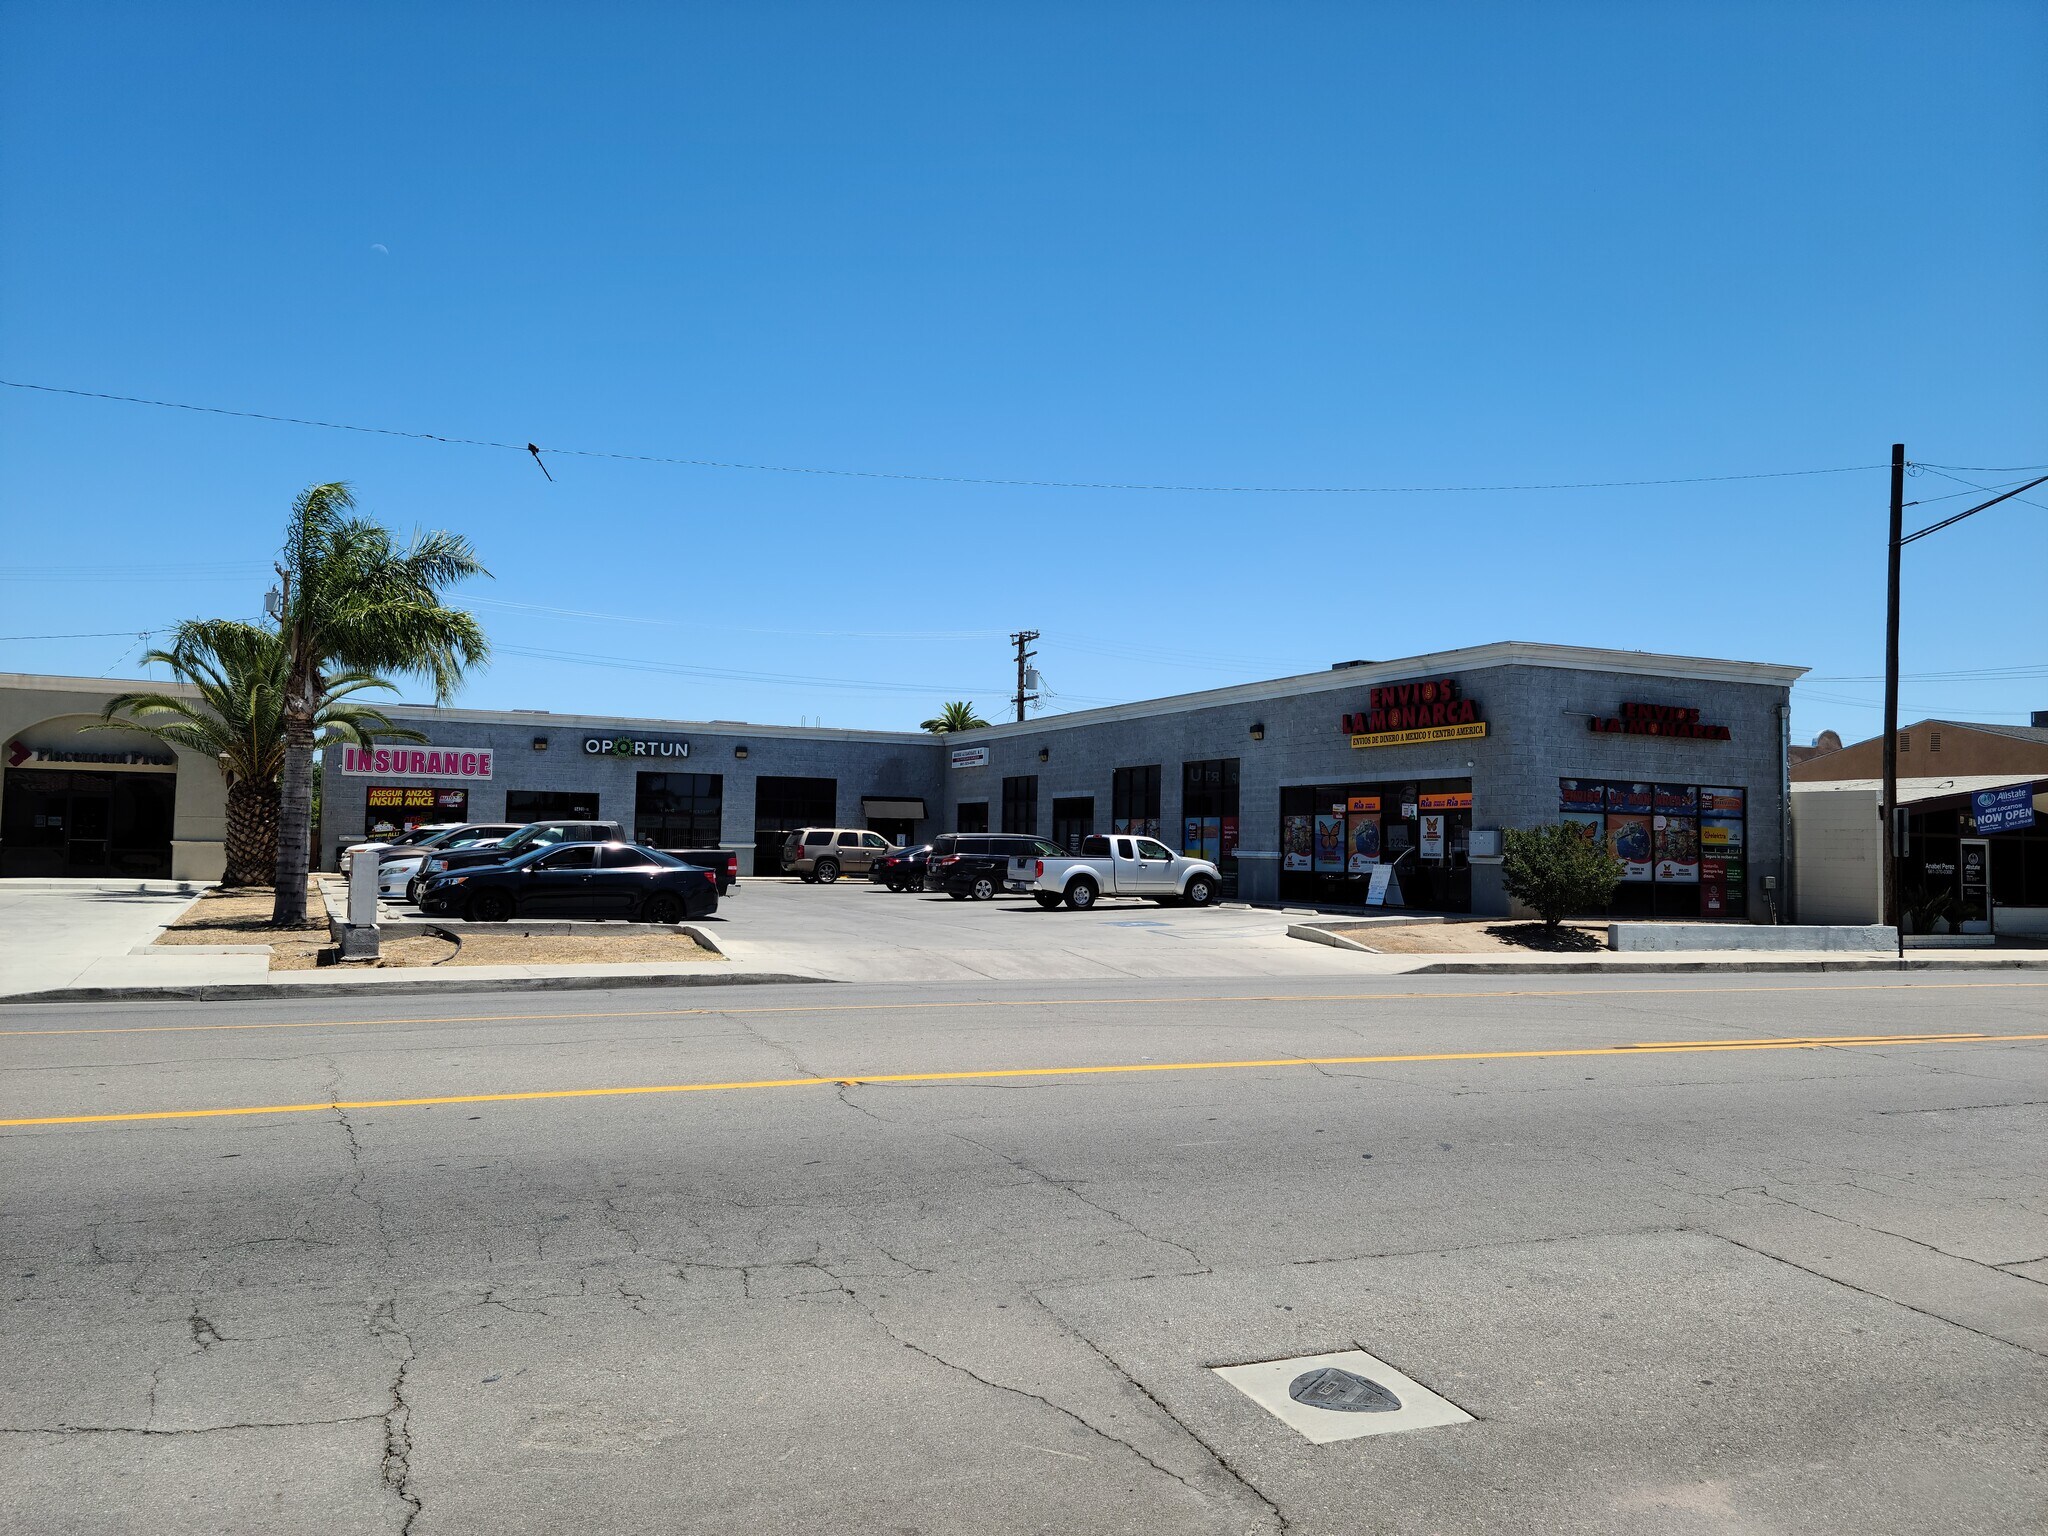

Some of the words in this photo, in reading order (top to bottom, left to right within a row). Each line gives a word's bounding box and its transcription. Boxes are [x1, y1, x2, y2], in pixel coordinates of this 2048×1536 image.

[1371, 679, 1454, 708] ENVIOS
[1343, 713, 1367, 734] LA
[1370, 700, 1476, 732] MONARCA
[1622, 703, 1699, 722] ENVIOS
[1353, 736, 1371, 746] ENVIOS
[1372, 735, 1379, 744] DE
[1380, 733, 1399, 743] DINERO
[1406, 731, 1426, 740] MEXICO
[1432, 728, 1455, 738] CENTRO
[1456, 726, 1484, 737] AMERICA
[1591, 717, 1620, 733] LA
[1626, 719, 1730, 740] MONARCA
[37, 747, 127, 763] Placement
[130, 752, 173, 765] Pros
[586, 738, 688, 757] OPORTUN
[346, 748, 491, 776] INSURANCE
[1996, 789, 2026, 801] Allstate
[1977, 813, 2003, 825] NOW
[2005, 808, 2032, 821] OPEN
[1997, 803, 2023, 812] LOCATION
[1925, 862, 1941, 870] Anabel
[1942, 862, 1955, 870] Perez
